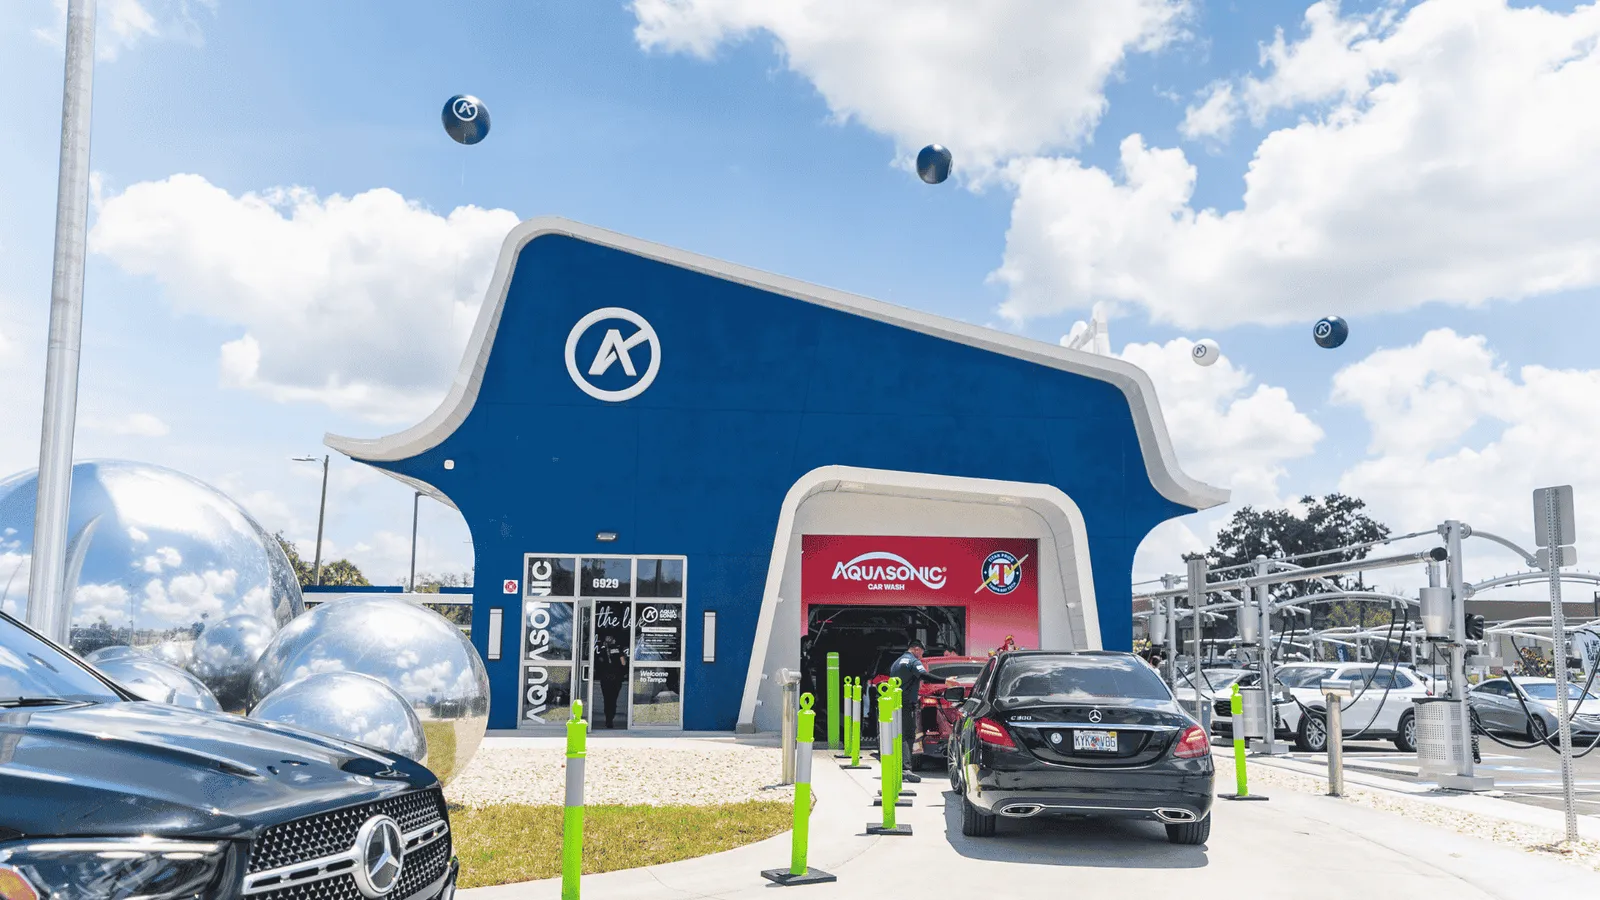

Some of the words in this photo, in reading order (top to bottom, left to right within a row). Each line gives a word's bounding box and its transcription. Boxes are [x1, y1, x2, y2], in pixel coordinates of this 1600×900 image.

[832, 557, 946, 586] AQUASONIC
[593, 578, 619, 588] 6929
[526, 560, 552, 724] AQUASONIC
[647, 676, 667, 684] Tampa
[1075, 735, 1091, 747] KYK
